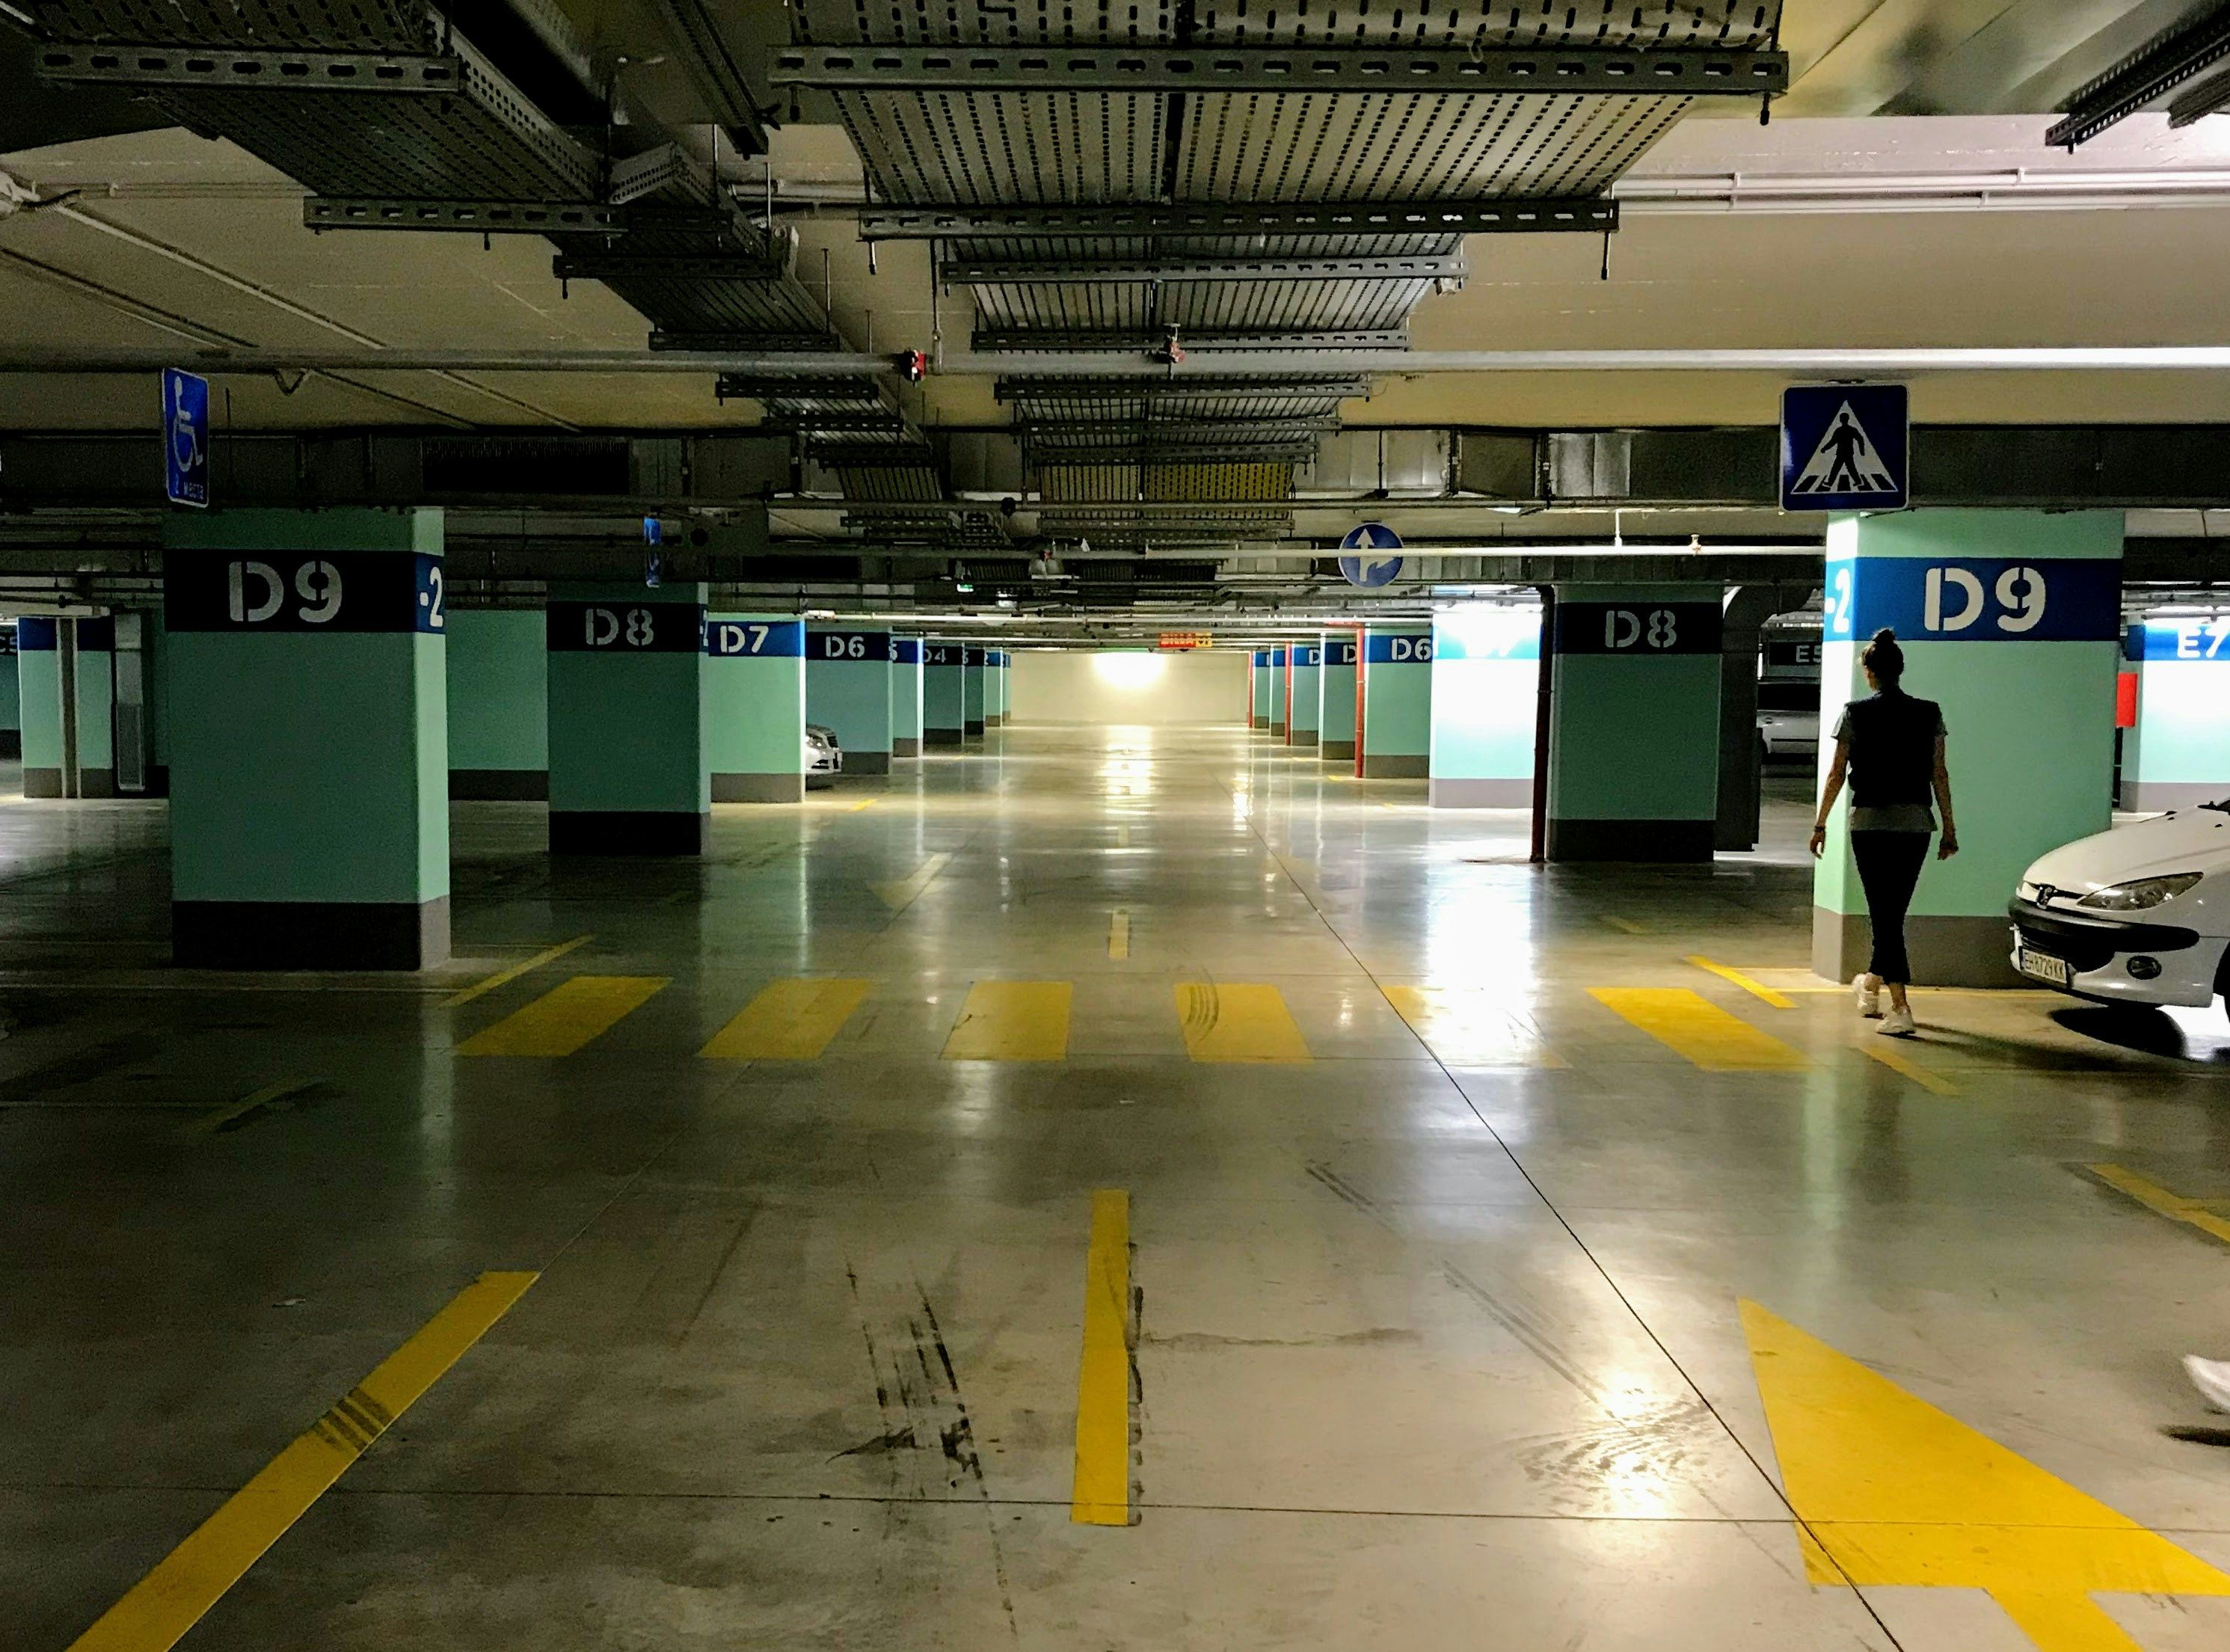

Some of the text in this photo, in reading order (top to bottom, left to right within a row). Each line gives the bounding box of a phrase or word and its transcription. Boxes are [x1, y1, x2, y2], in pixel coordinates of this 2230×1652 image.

[229, 561, 343, 623] D9
[420, 566, 443, 627] -2
[1824, 568, 1851, 633] -2
[1924, 567, 2046, 633] D9
[586, 609, 654, 646] D8
[719, 625, 769, 654] D7
[825, 636, 865, 657] D6
[1605, 609, 1677, 648] D8
[2177, 625, 2230, 658] E7
[1392, 638, 1432, 660] D6
